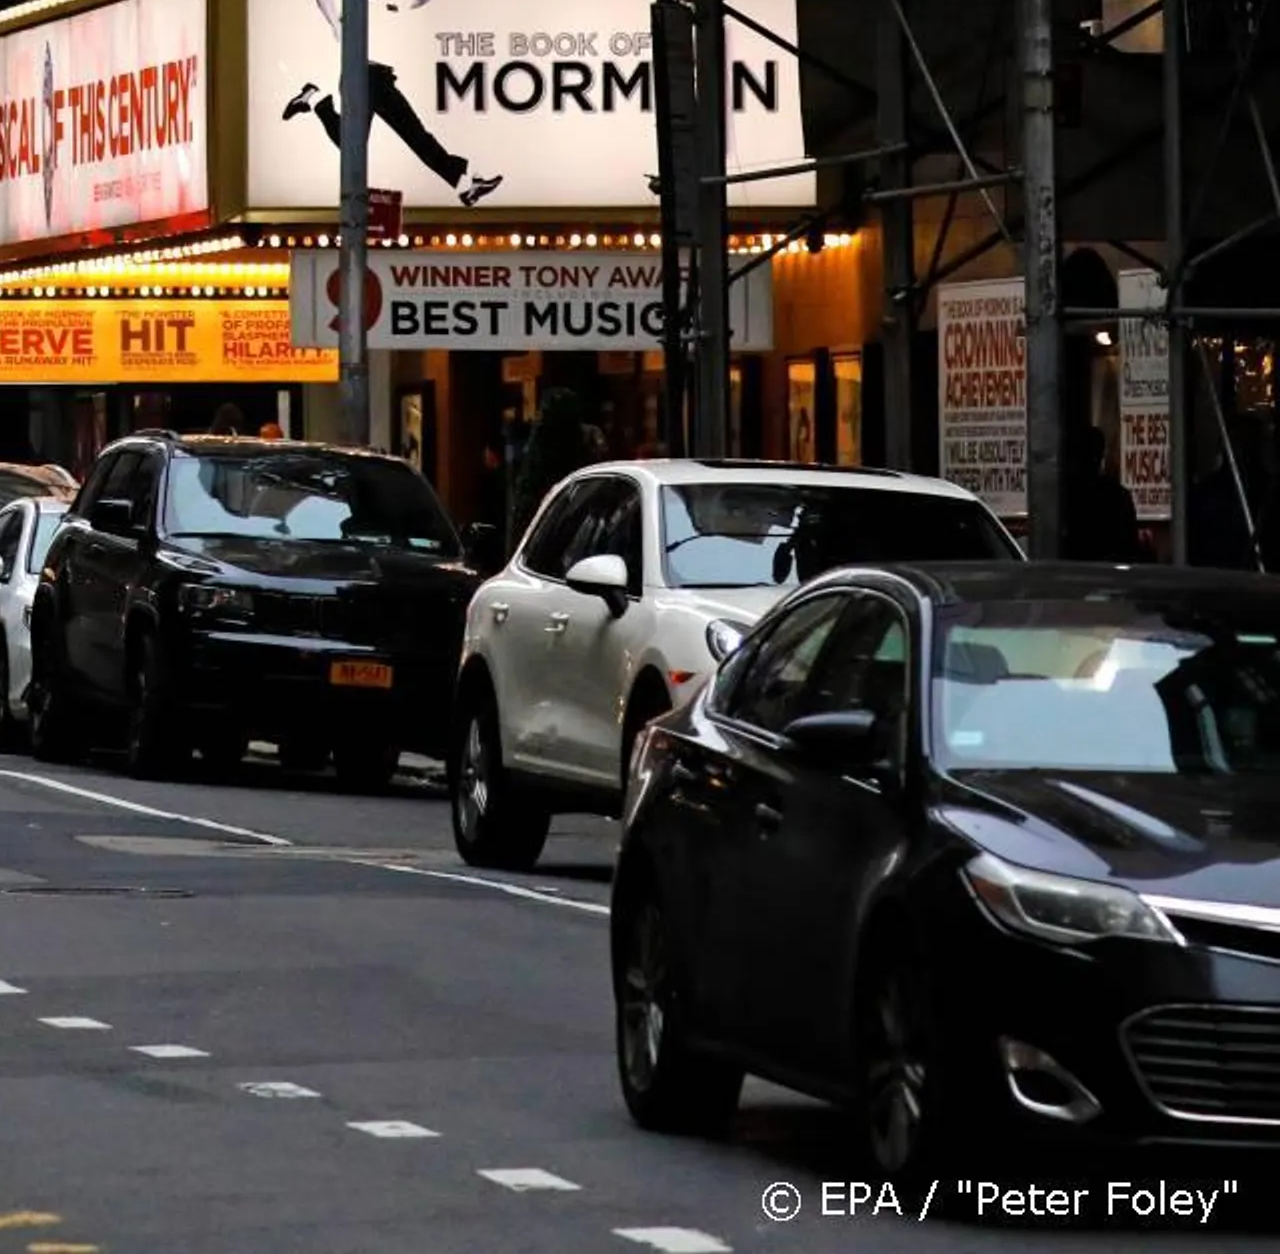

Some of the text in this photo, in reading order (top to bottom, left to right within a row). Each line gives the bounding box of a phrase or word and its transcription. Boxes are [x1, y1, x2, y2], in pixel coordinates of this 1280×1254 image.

[435, 32, 653, 57] THE BOOK OF
[435, 59, 780, 114] MORMN
[68, 79, 105, 166] THIS
[390, 265, 511, 288] WINNER
[519, 265, 600, 288] TONY
[120, 319, 195, 352] HIT
[223, 320, 292, 331] OF PROFA
[390, 302, 666, 336] BEST MUSIC
[5, 356, 68, 366] RUNAWAY
[944, 321, 1025, 368] CROWNING
[1125, 450, 1171, 484] MUSICA
